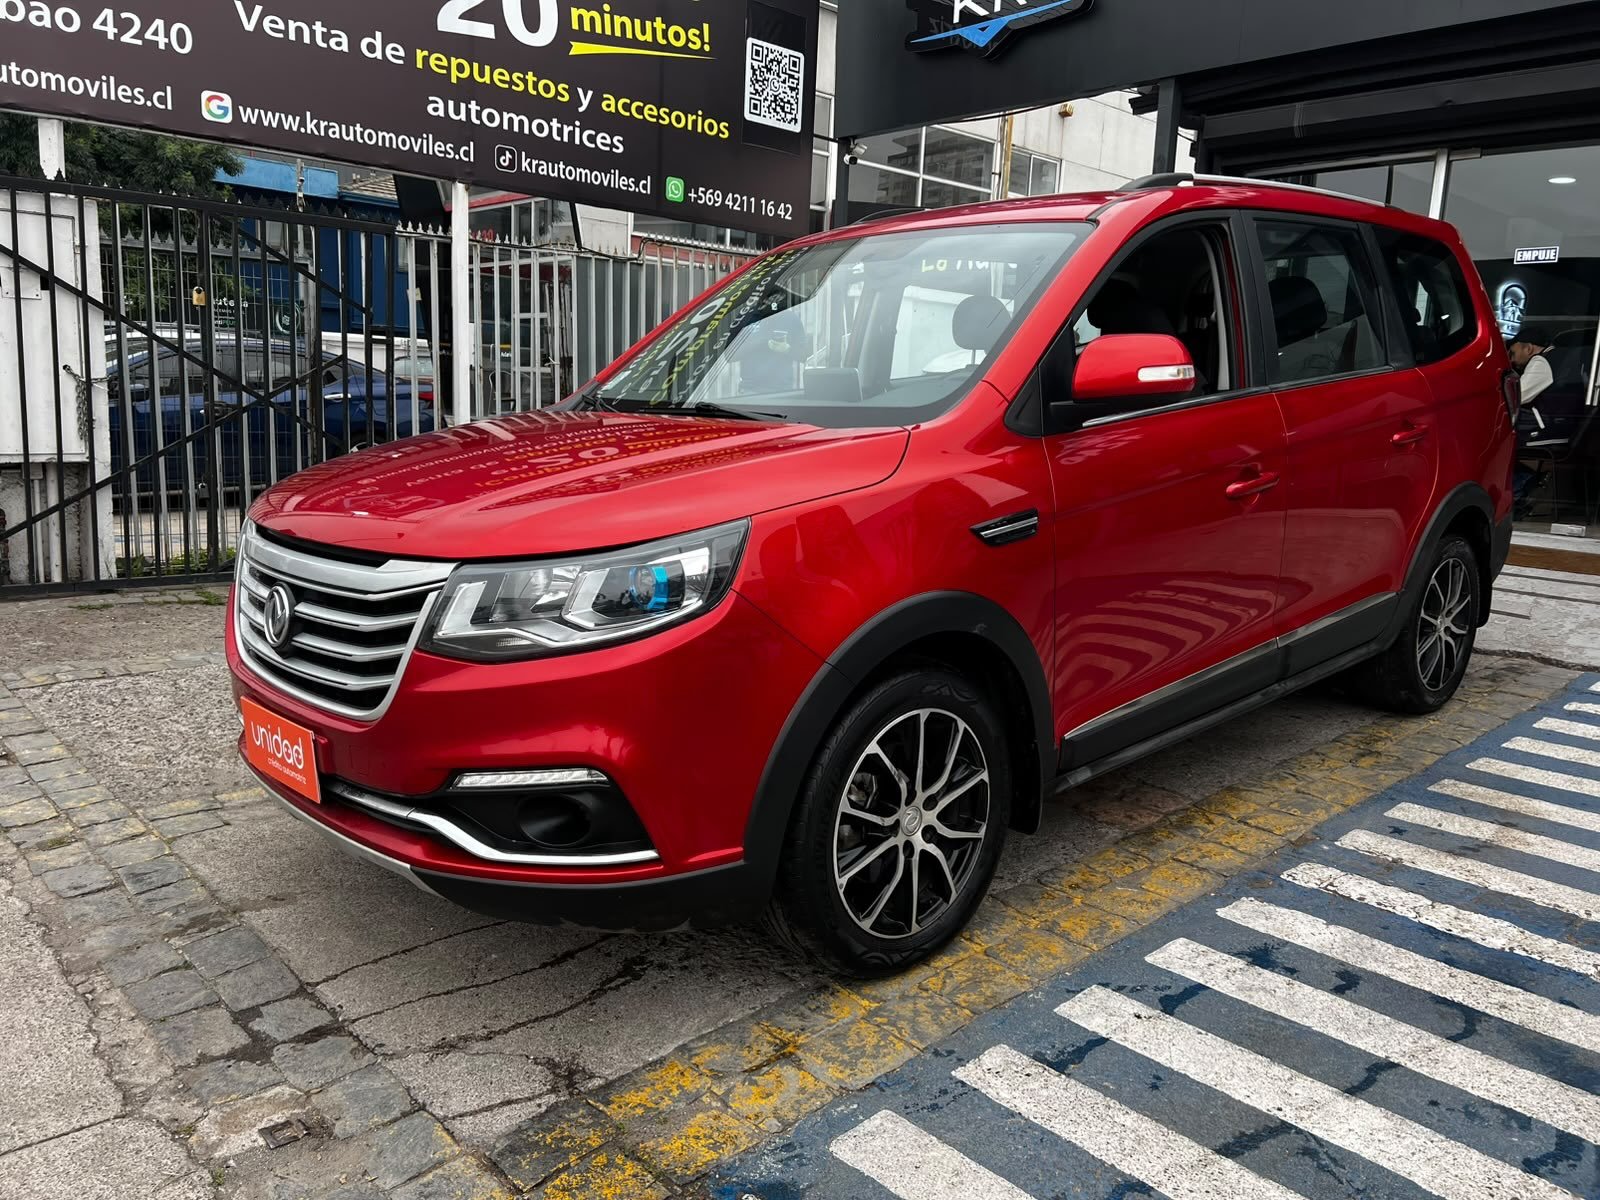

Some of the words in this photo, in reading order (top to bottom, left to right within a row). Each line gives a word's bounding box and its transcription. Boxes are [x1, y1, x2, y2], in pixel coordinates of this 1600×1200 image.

[92, 8, 193, 54] 4240
[570, 3, 711, 52] minutos!
[234, 0, 349, 53] Venta
[360, 31, 406, 64] de
[415, 47, 570, 102] repuestos
[576, 88, 593, 112] y
[601, 91, 730, 139] accesorios
[238, 104, 475, 163] www.krautomoviles.cl
[427, 95, 625, 153] automotrices
[521, 151, 651, 195] krautomoviles.cl
[687, 185, 722, 207] +569
[724, 191, 756, 214] 4211
[760, 198, 775, 217] 16
[776, 202, 793, 221] 42
[1517, 248, 1557, 261] EMPUJE
[251, 721, 304, 769] unidad
